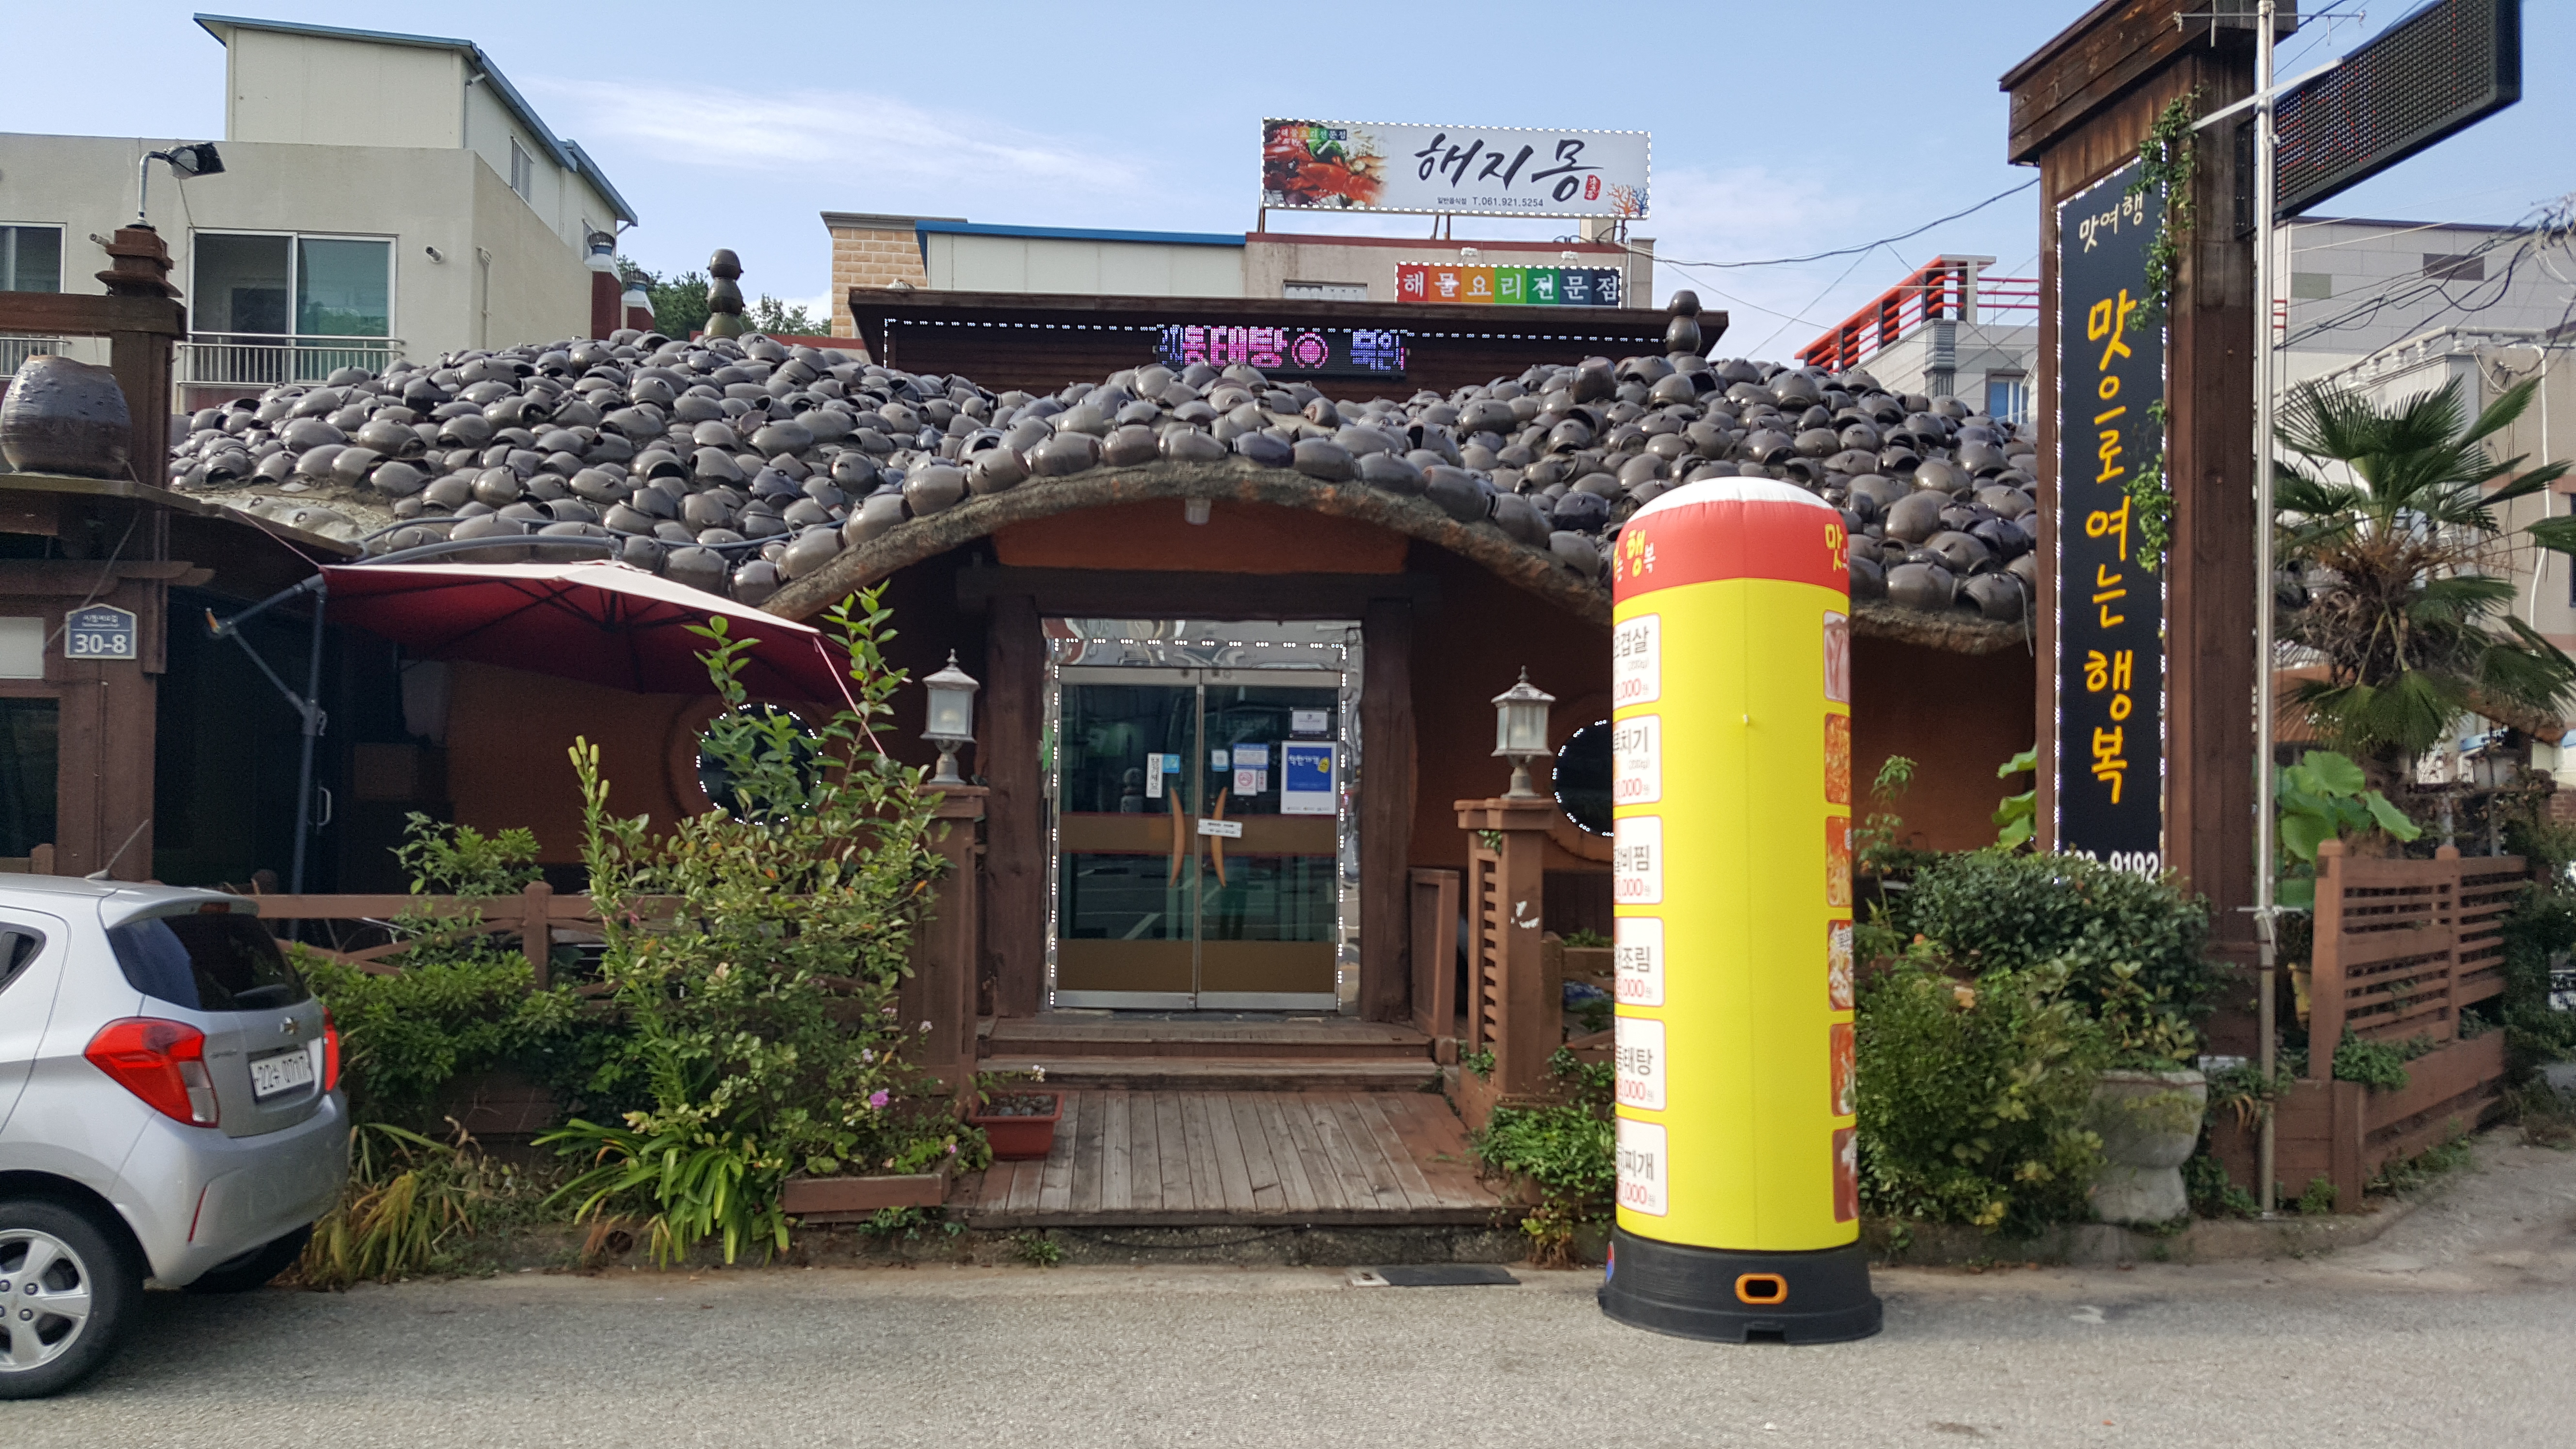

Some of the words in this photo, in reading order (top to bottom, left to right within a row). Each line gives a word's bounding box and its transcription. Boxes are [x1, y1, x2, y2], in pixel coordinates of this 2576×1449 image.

[1414, 132, 1604, 202] 해지몽
[1403, 270, 1618, 303] 해물요리전문점
[74, 633, 128, 654] 30-8
